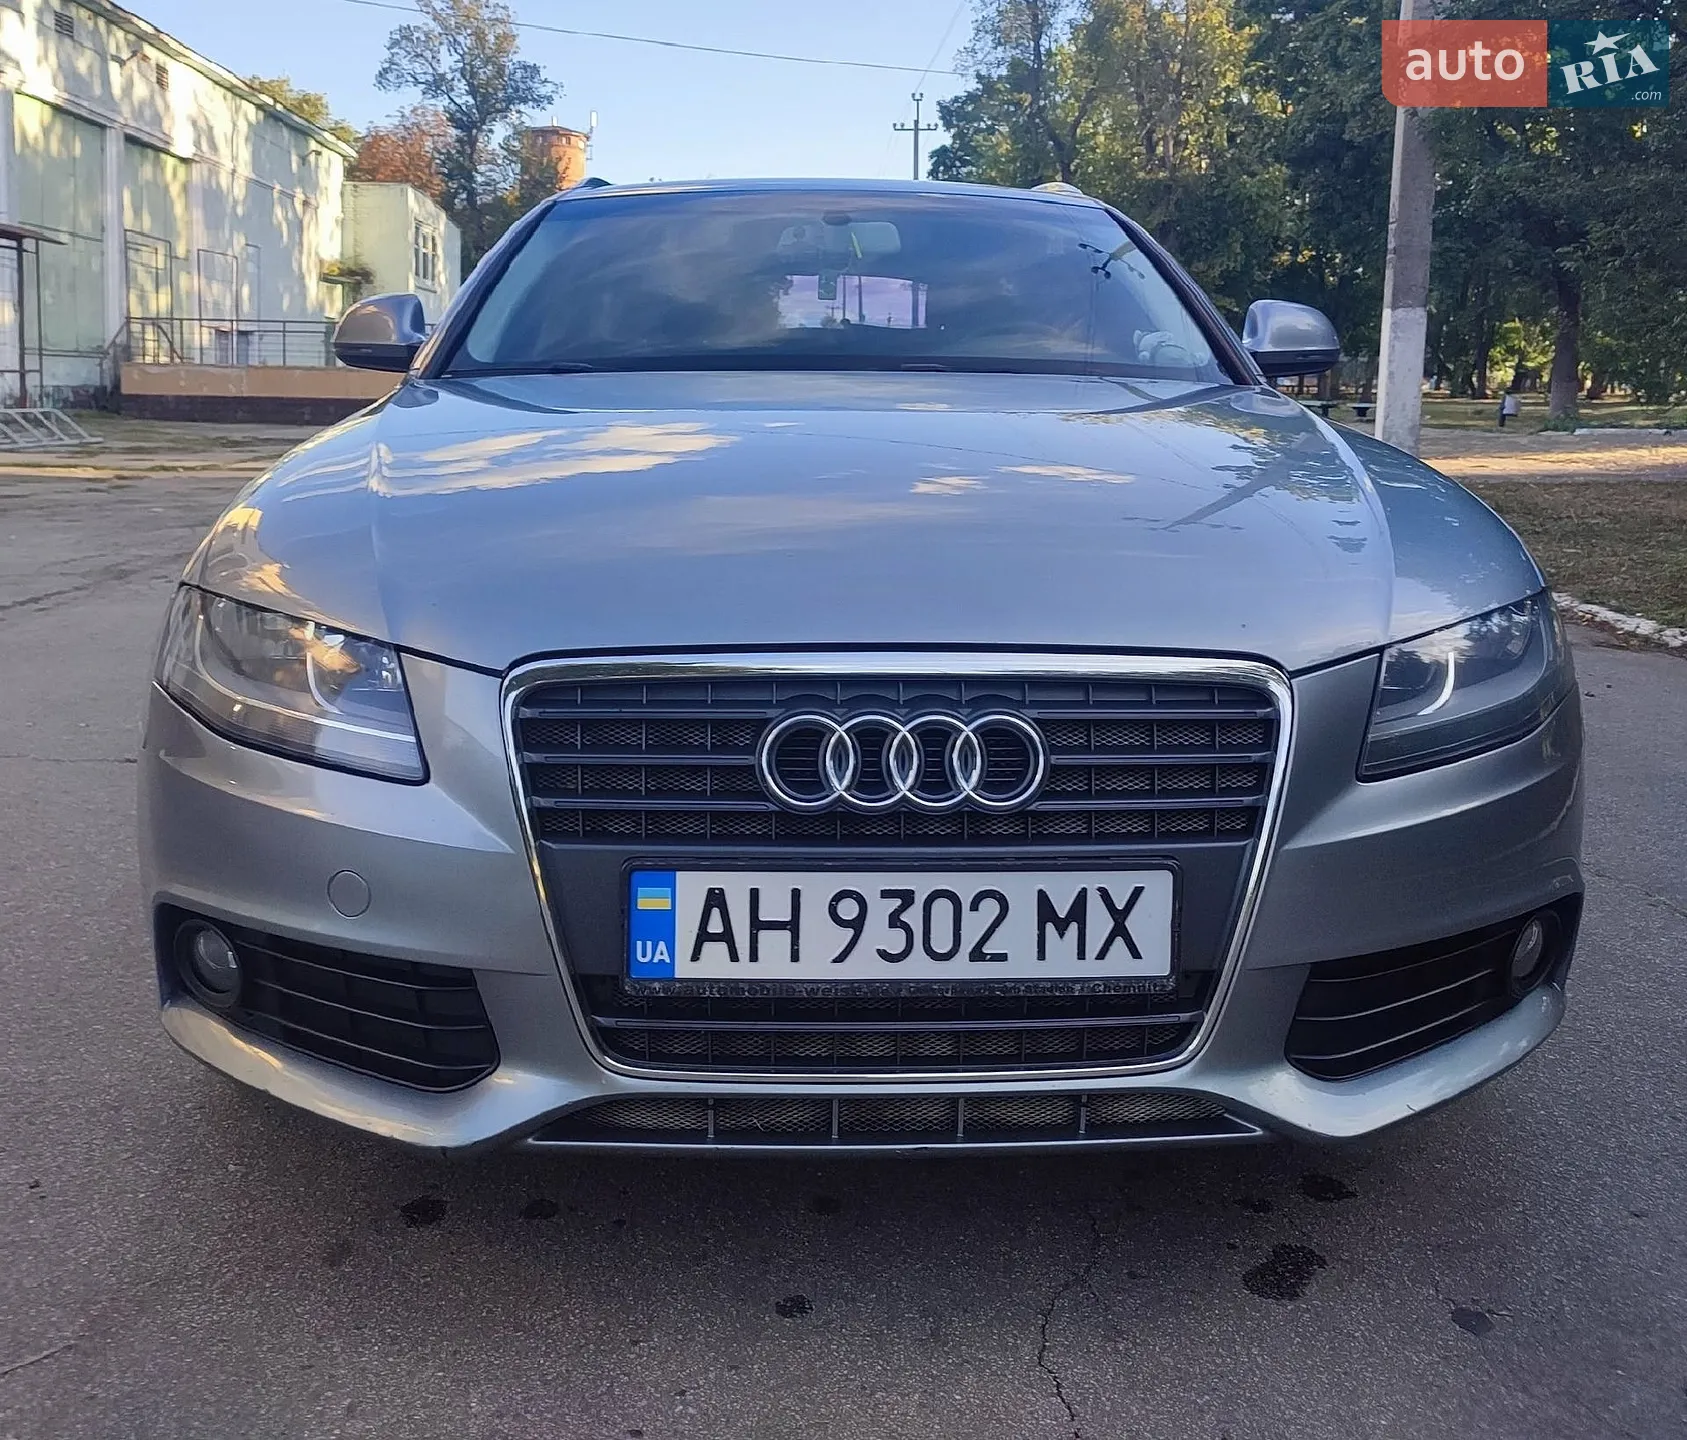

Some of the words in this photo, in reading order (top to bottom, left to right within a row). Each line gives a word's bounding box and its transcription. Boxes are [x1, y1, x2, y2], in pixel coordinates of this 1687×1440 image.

[690, 886, 801, 963] AH
[828, 887, 1010, 964] 9302
[1036, 885, 1146, 961] MX
[636, 940, 671, 964] UA
